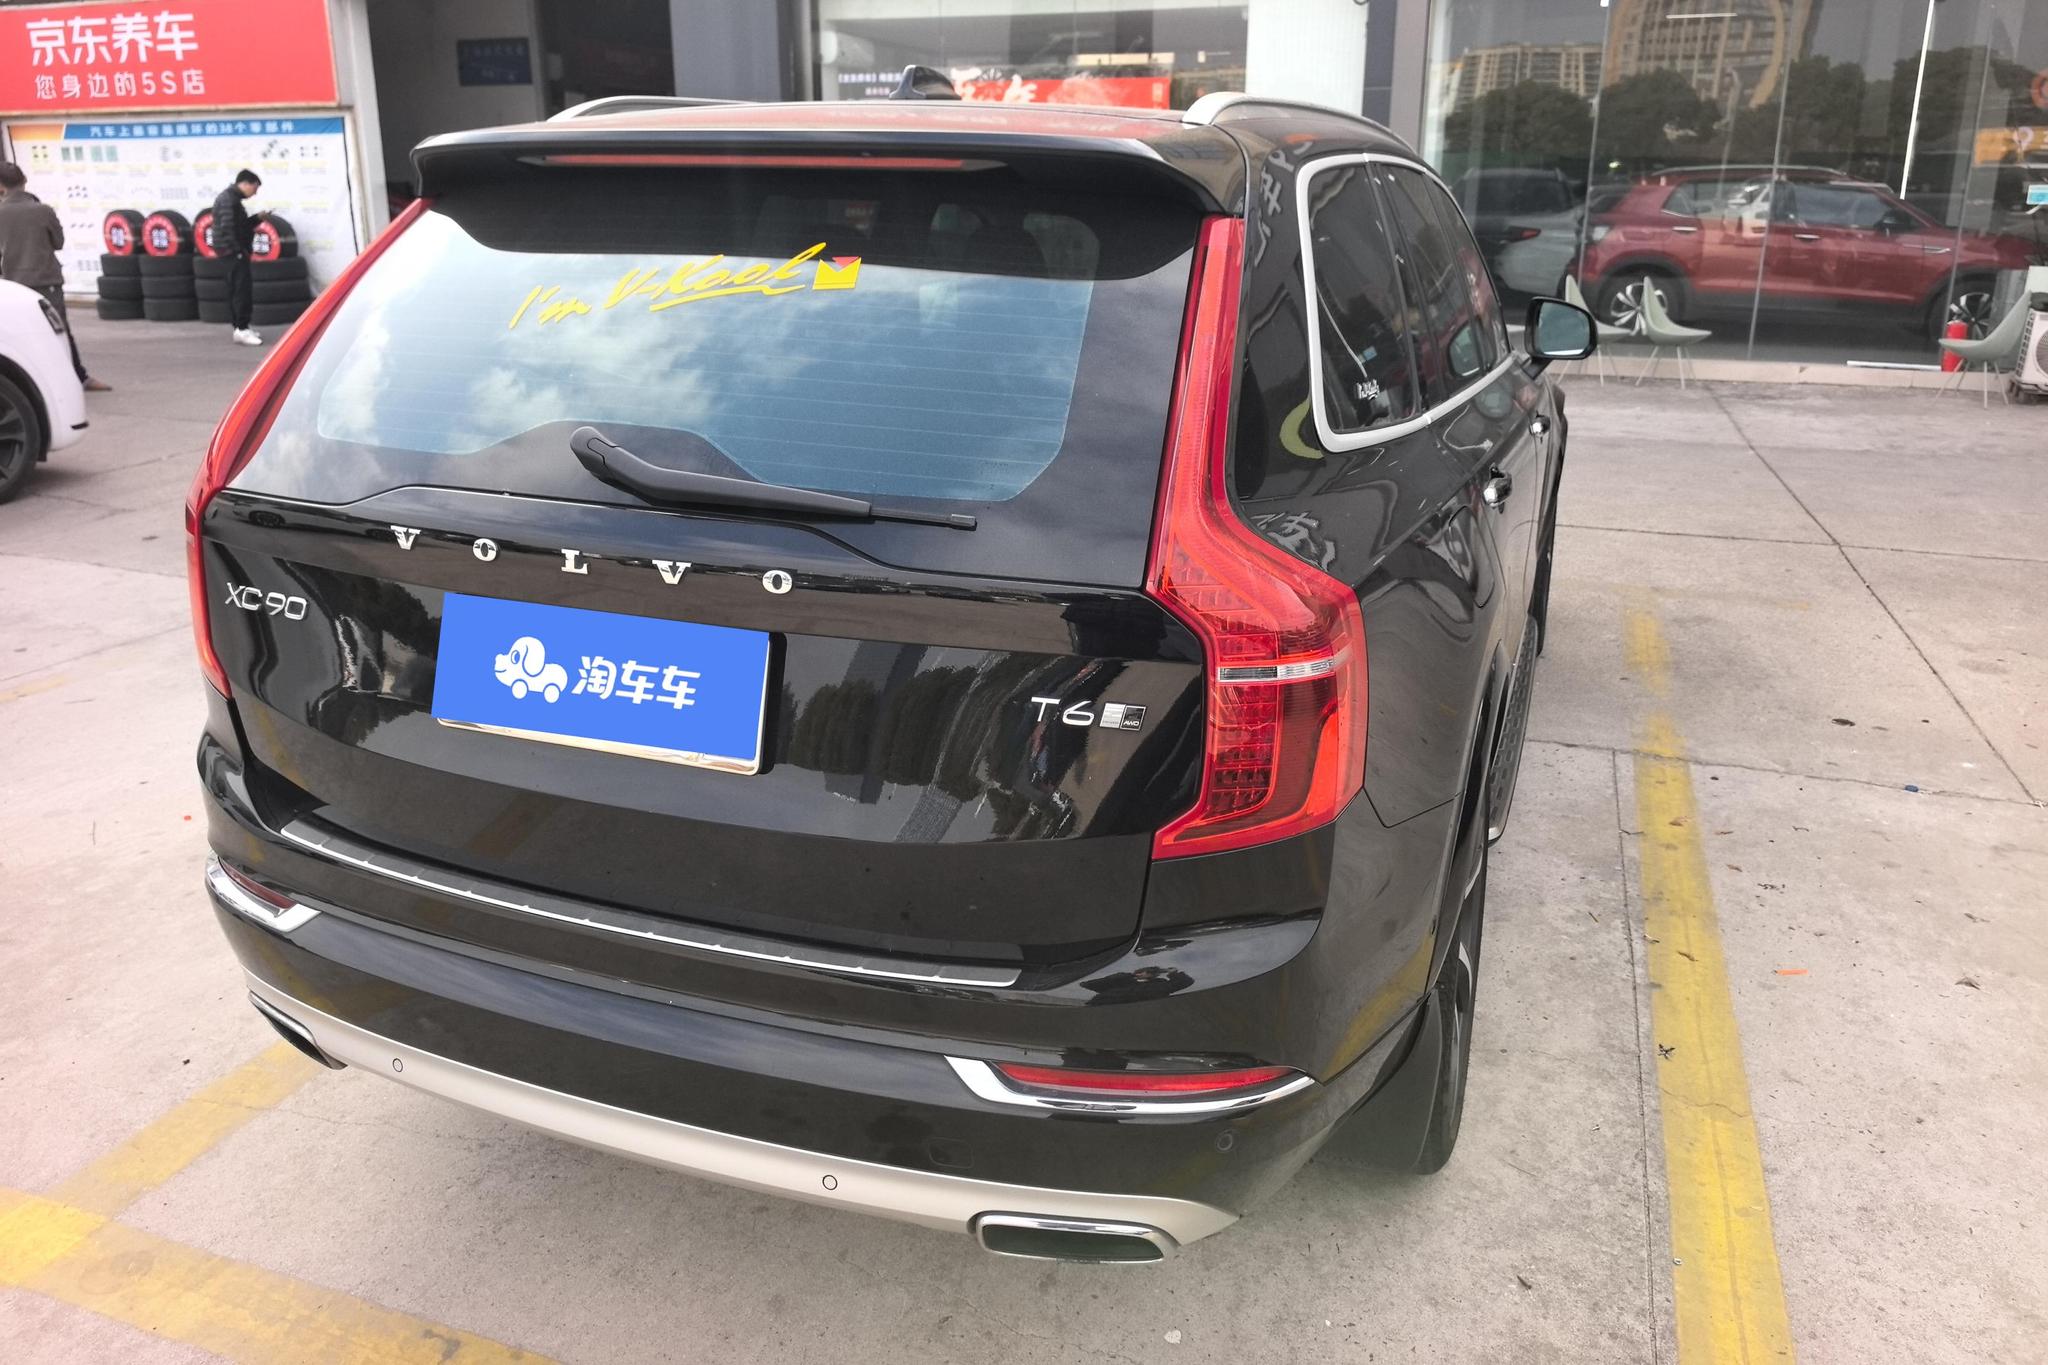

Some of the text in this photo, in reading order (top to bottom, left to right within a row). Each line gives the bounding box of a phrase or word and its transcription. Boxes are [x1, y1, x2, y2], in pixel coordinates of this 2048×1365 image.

[26, 11, 198, 66] 京东养车
[35, 69, 206, 99] 您身边的5S店
[390, 525, 793, 594] VOLVO
[225, 582, 307, 620] XC90
[1031, 697, 1094, 726] T6
